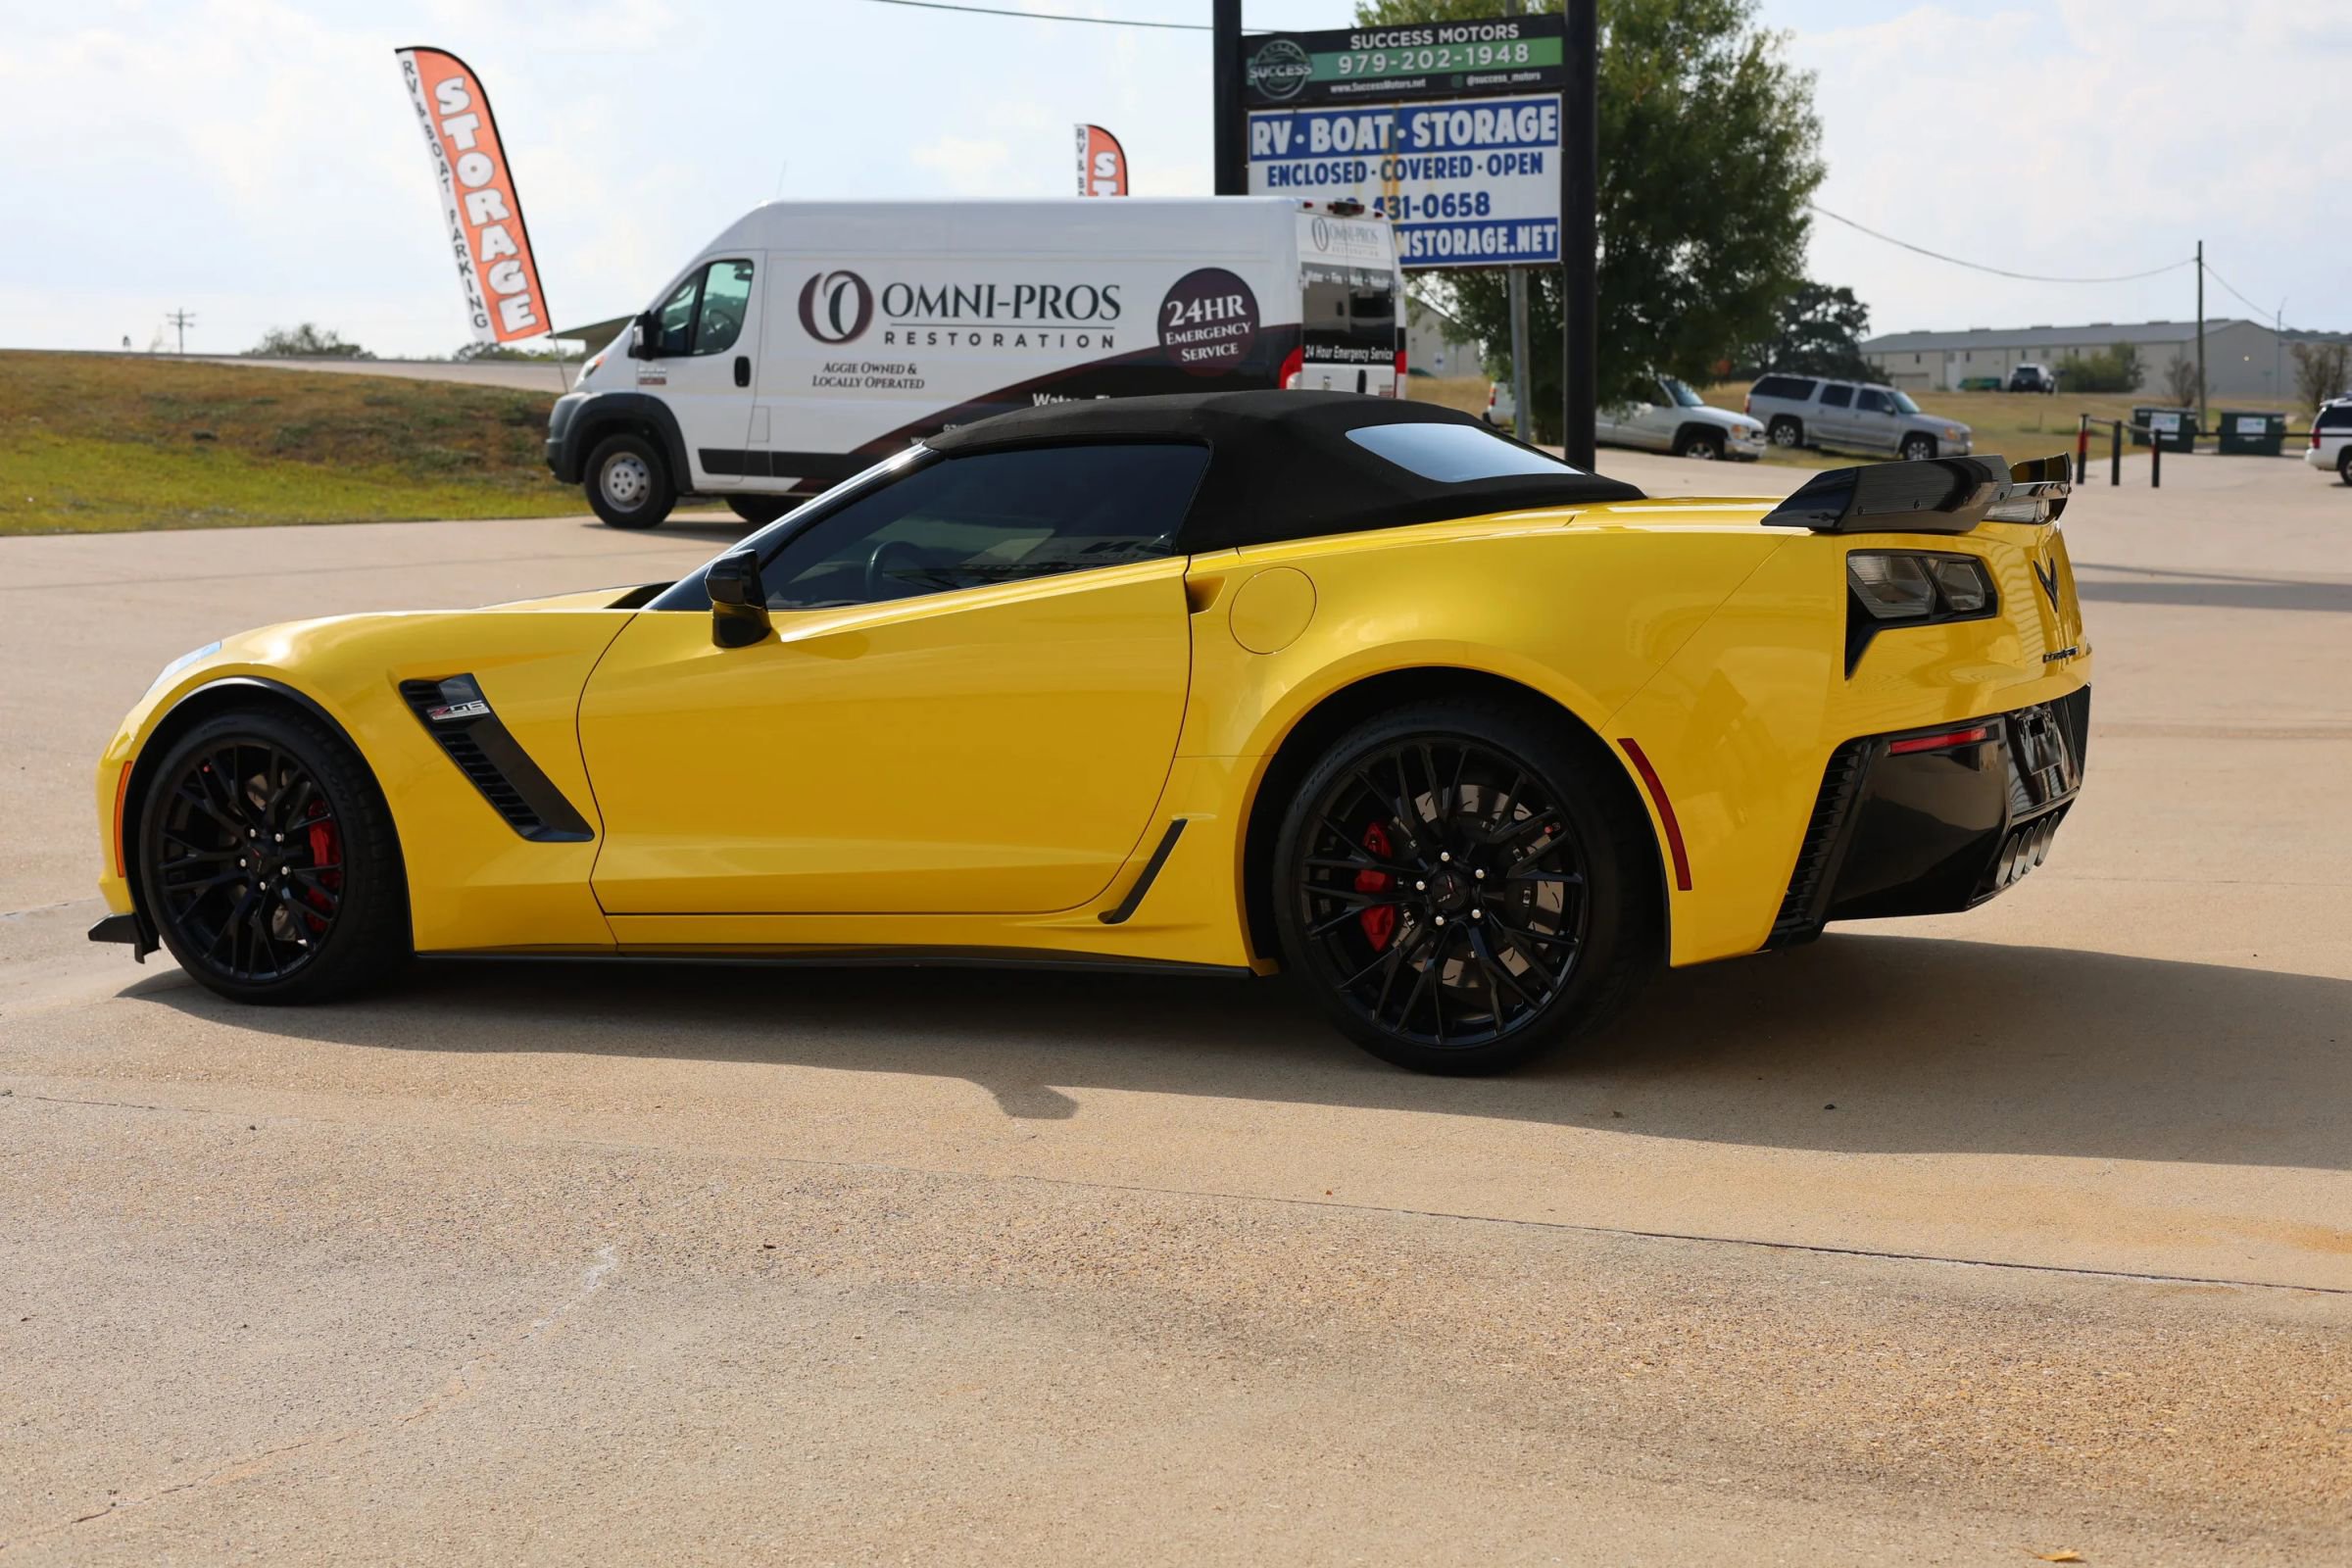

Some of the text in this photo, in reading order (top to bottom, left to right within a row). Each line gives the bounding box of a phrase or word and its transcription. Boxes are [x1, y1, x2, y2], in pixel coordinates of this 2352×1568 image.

[1350, 24, 1519, 50] SUCCESS MOTORS
[1249, 62, 1313, 79] SUCCESS
[1338, 43, 1529, 74] 979-202-1948
[1251, 106, 1557, 156] RV BOAT STORAGE
[1267, 151, 1544, 187] ENCLOSED COVERED OPEN
[403, 60, 417, 94] RV
[424, 123, 450, 193] BOAT
[450, 209, 488, 329] PARKING
[434, 74, 539, 335] STORAGE
[881, 282, 1121, 320] OMNI-PROS
[1167, 294, 1248, 326] 24HR
[885, 331, 1114, 349] RESTORATION
[1165, 321, 1252, 345] EMERGENCY
[1181, 342, 1240, 362] SERVICE
[1305, 345, 1395, 363] 24 Hour Emergency Service
[906, 364, 917, 374] &
